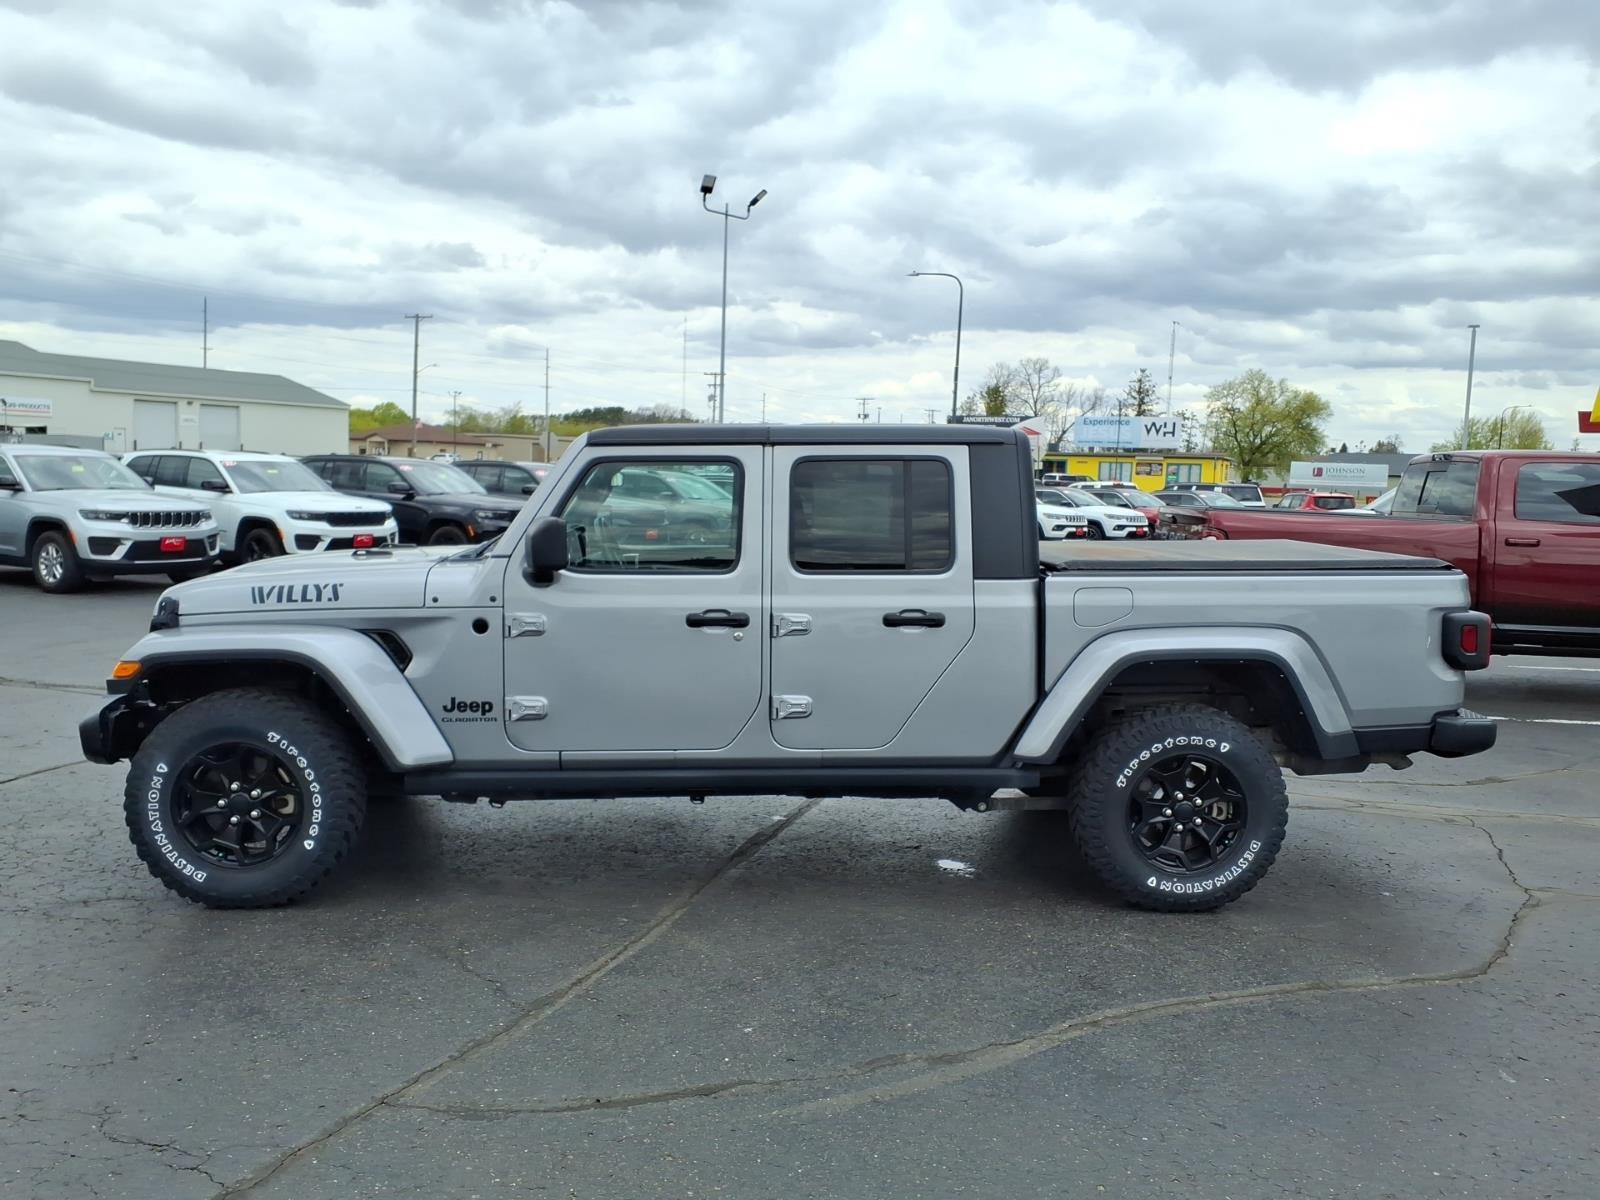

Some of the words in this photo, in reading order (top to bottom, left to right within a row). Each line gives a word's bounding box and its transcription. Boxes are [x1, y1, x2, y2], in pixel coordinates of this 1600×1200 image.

[1083, 418, 1131, 426] Experience
[1326, 467, 1366, 475] JOHNSON
[250, 583, 344, 604] WILLYS
[442, 696, 494, 716] Jeep
[1117, 736, 1217, 788] Firestone
[267, 731, 322, 837] Firestone
[148, 776, 206, 882] DESTINATION
[1160, 840, 1261, 894] DESTINATION
